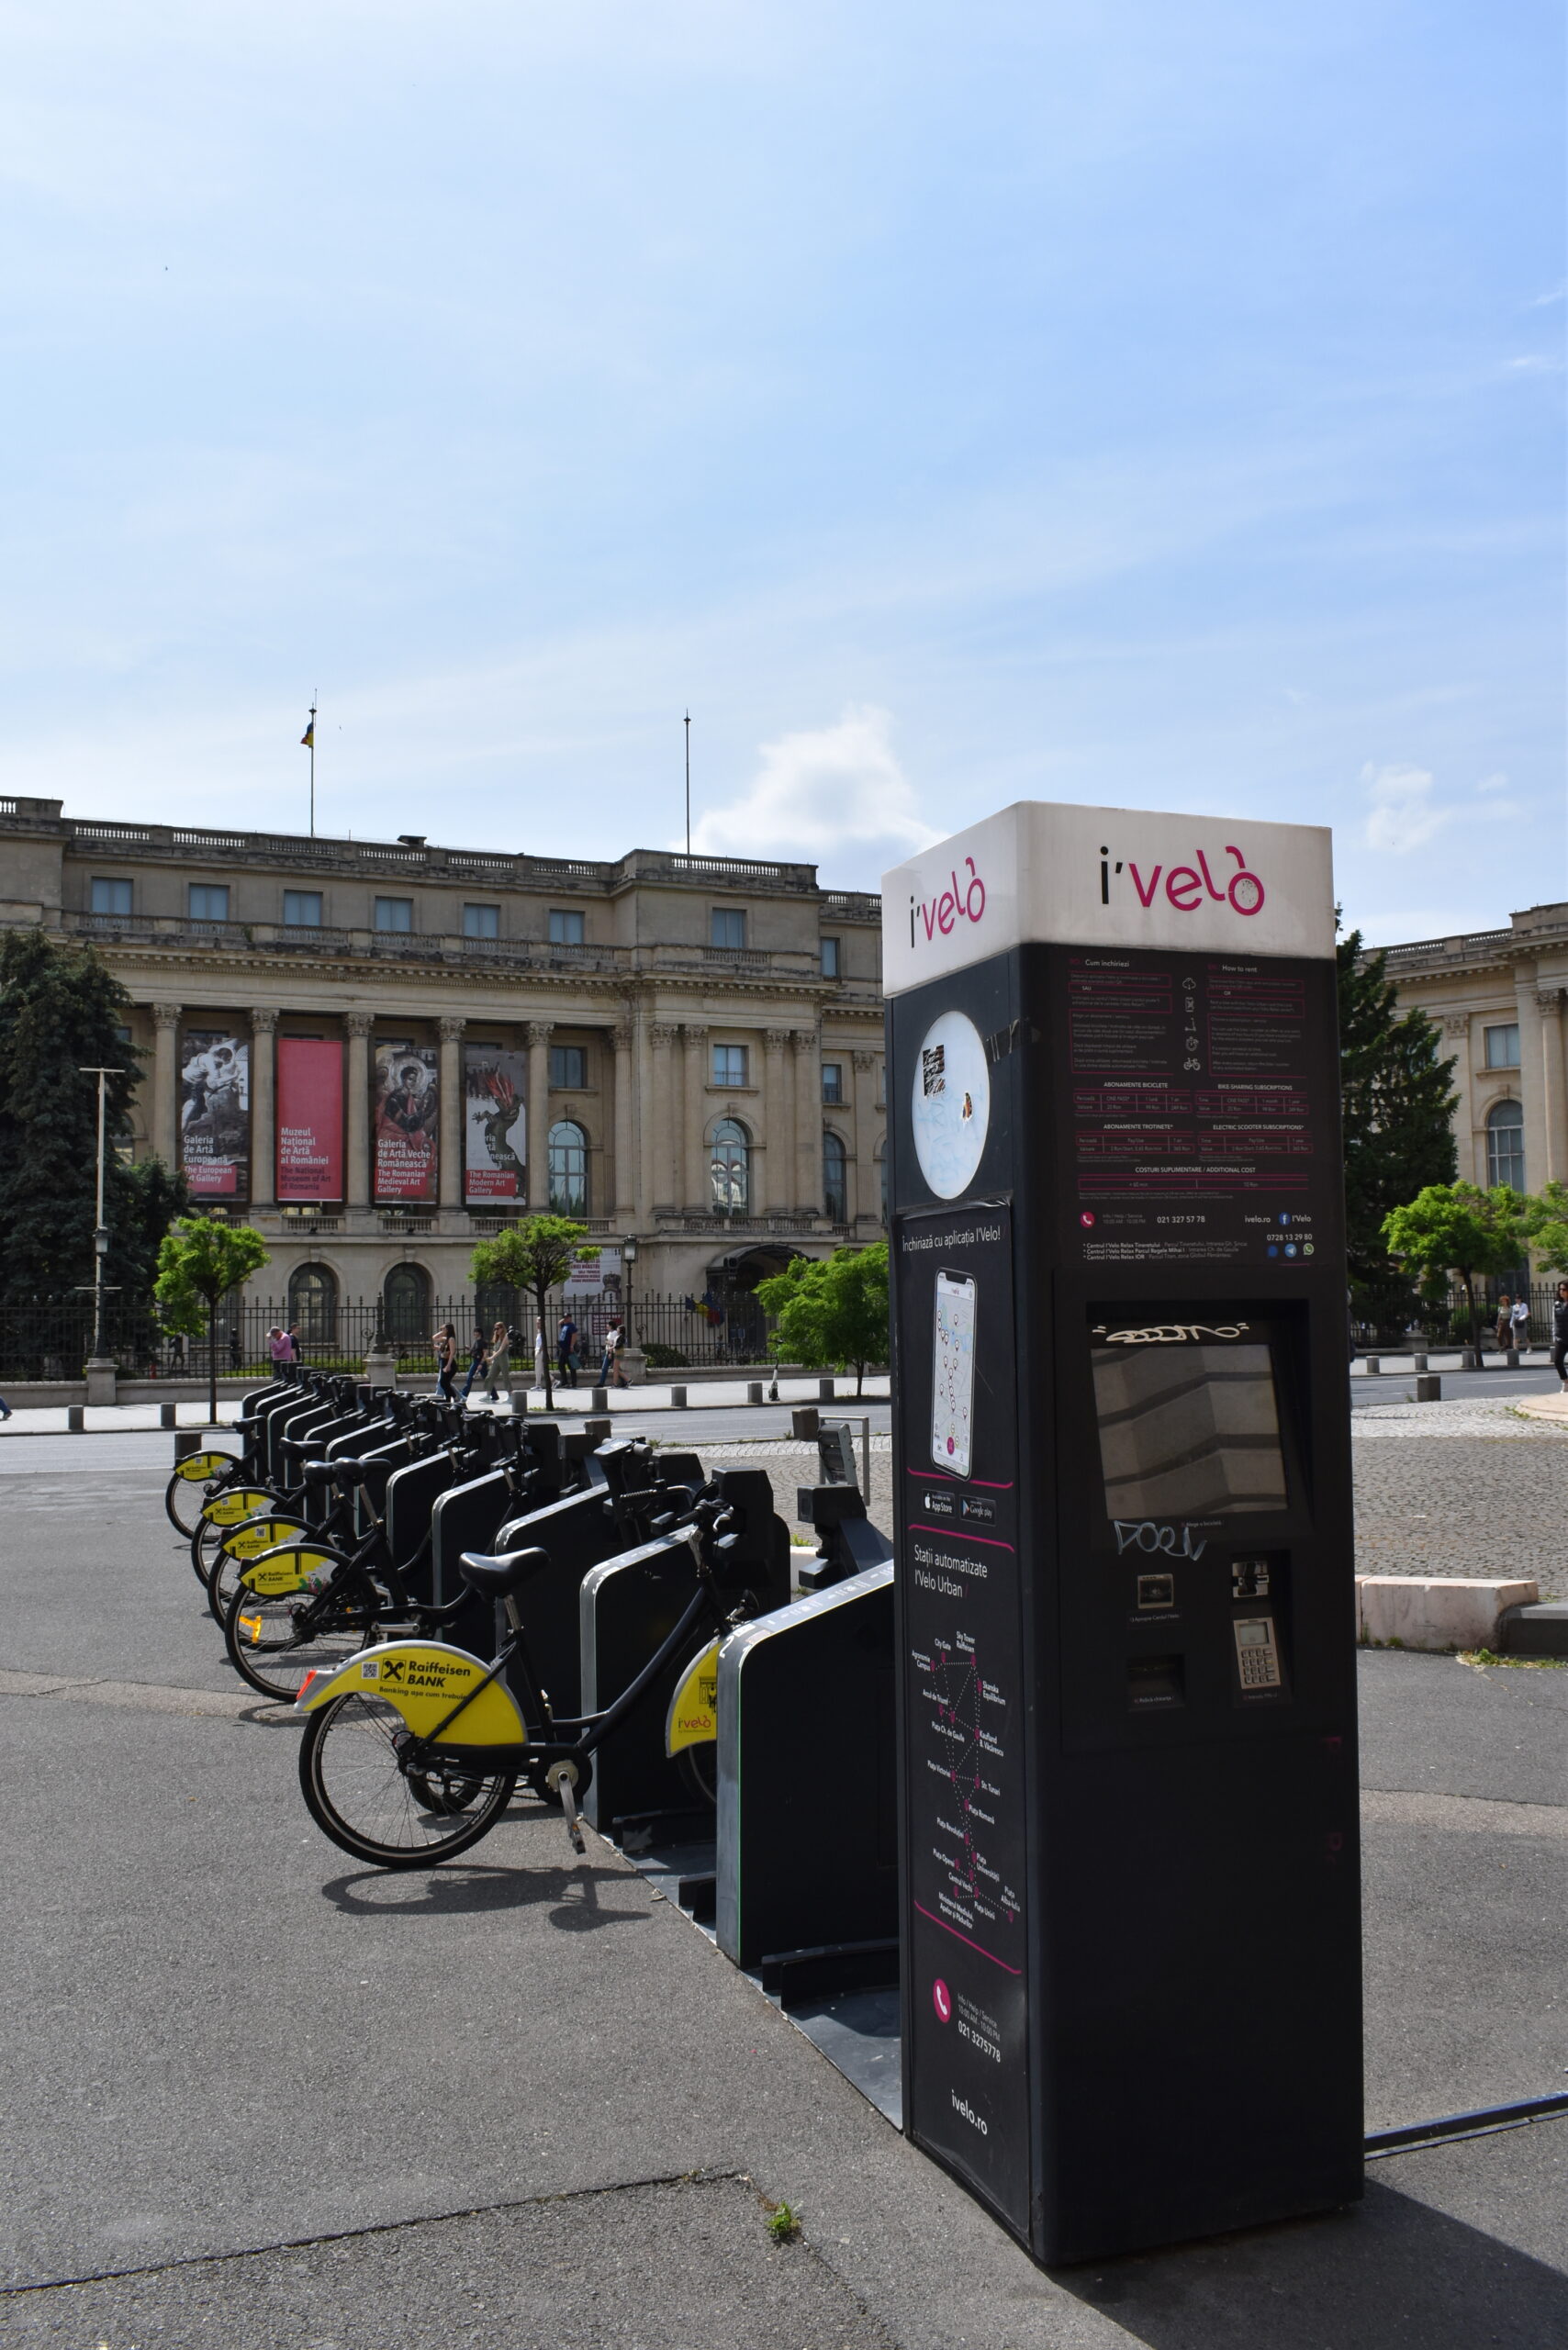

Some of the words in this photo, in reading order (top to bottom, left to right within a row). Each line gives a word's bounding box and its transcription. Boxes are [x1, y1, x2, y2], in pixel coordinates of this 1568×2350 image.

[281, 1127, 311, 1136] Muzeul
[184, 1135, 214, 1145] Galeria
[377, 1138, 406, 1148] Galeria
[184, 1145, 195, 1154] de
[196, 1145, 214, 1154] Artă
[281, 1146, 291, 1155] de
[292, 1146, 310, 1155] Artă
[377, 1148, 388, 1158] de
[389, 1148, 406, 1158] Artă
[408, 1149, 431, 1158] Veche
[184, 1154, 229, 1164] Europeană
[281, 1156, 289, 1164] al
[290, 1156, 329, 1165] României
[377, 1158, 427, 1168] Românească
[185, 1166, 197, 1174] The
[198, 1166, 232, 1175] European
[281, 1166, 294, 1174] The
[377, 1169, 391, 1177] The
[196, 1174, 222, 1183] Gallery
[320, 1175, 331, 1183] Art
[377, 1177, 409, 1185] Medieval
[281, 1182, 287, 1191] of
[377, 1184, 402, 1194] Gallery
[469, 1186, 493, 1194] Gallery
[1244, 1214, 1271, 1224] ivelo.ro
[934, 1237, 943, 1248] cu
[932, 1501, 941, 1514] App
[940, 1502, 952, 1514] Store
[969, 1505, 984, 1518] Google
[935, 1552, 988, 1578] automatizate
[937, 1575, 963, 1597] Urban
[719, 1635, 735, 1659] 2
[409, 1661, 471, 1676] Raiffeisen
[407, 1674, 446, 1687] BANK
[379, 1686, 409, 1696] Banking
[982, 1690, 1006, 1706] Equilibrium
[958, 2020, 970, 2039] 021
[971, 2030, 1002, 2063] 3275778
[951, 2087, 988, 2136] ivelo.ro
